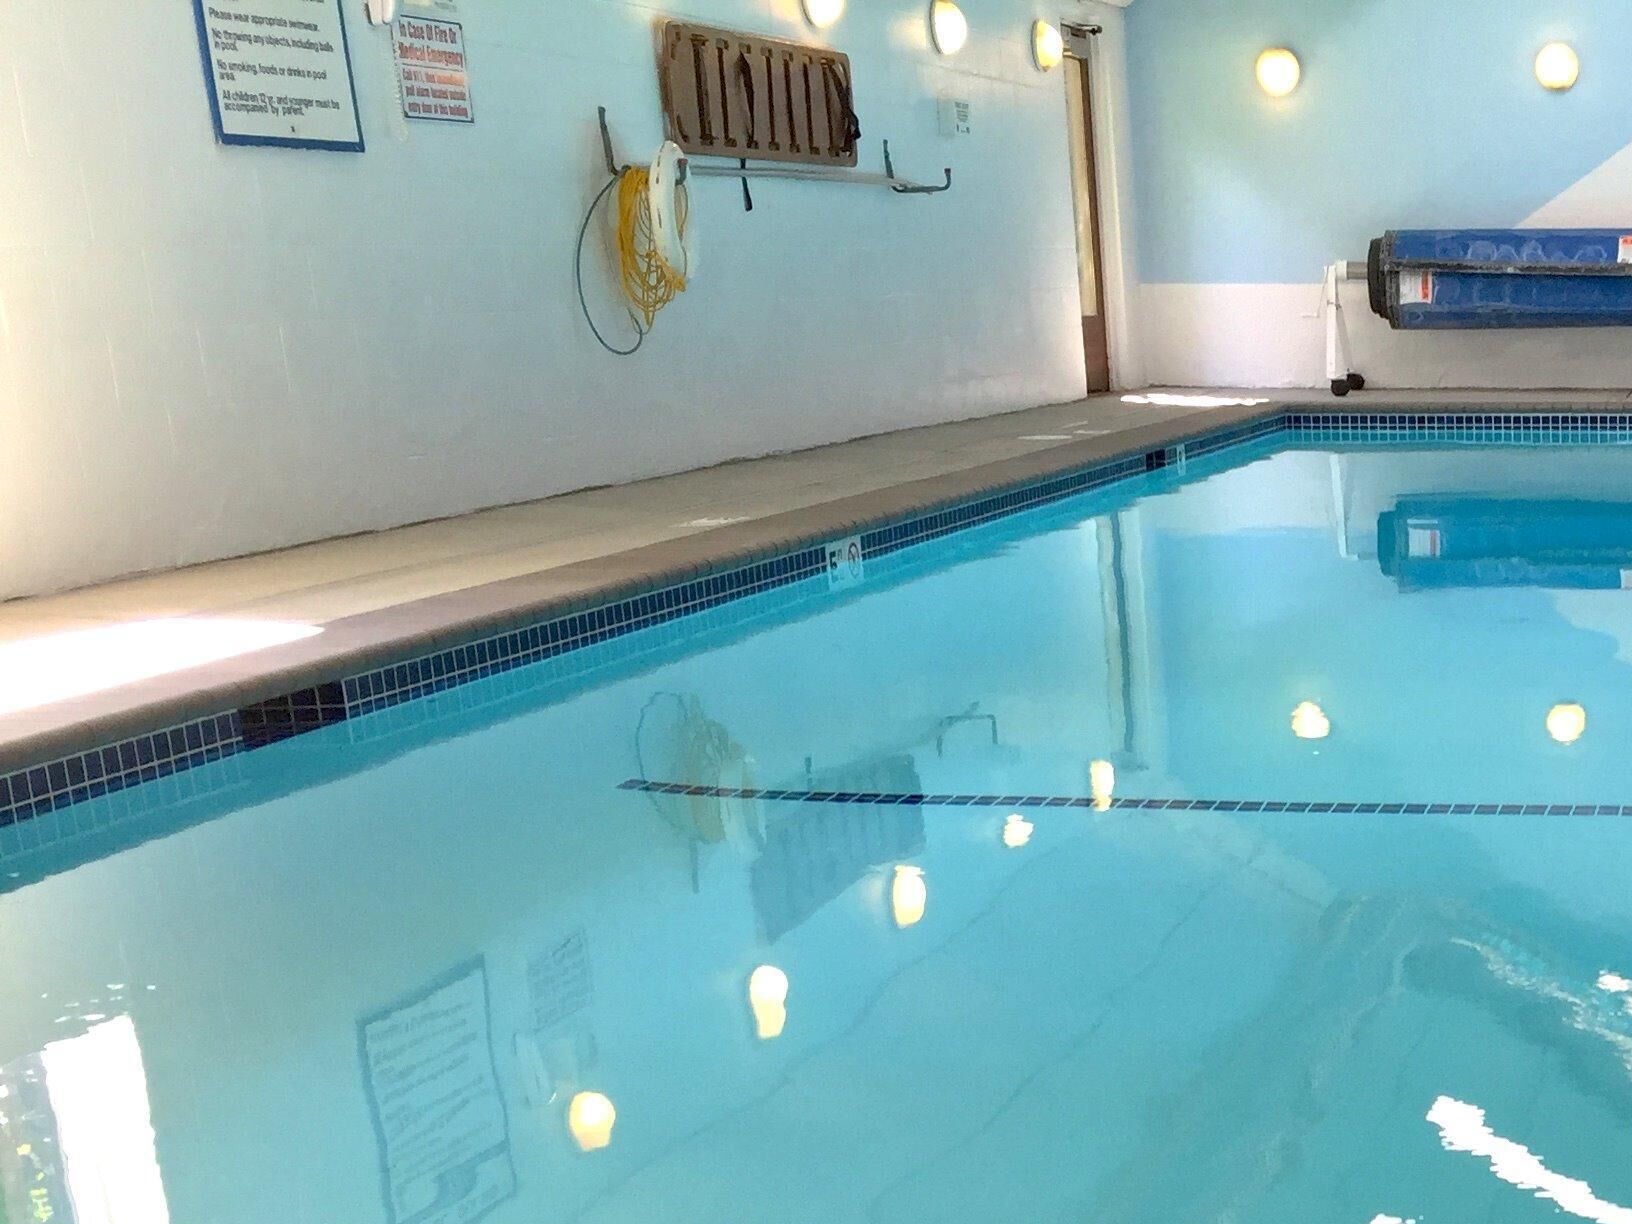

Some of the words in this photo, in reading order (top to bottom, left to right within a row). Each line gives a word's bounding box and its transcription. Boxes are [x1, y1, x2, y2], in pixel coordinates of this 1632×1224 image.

[217, 59, 227, 70] No
[232, 91, 259, 103] children
[277, 96, 288, 105] and
[271, 105, 279, 116] by
